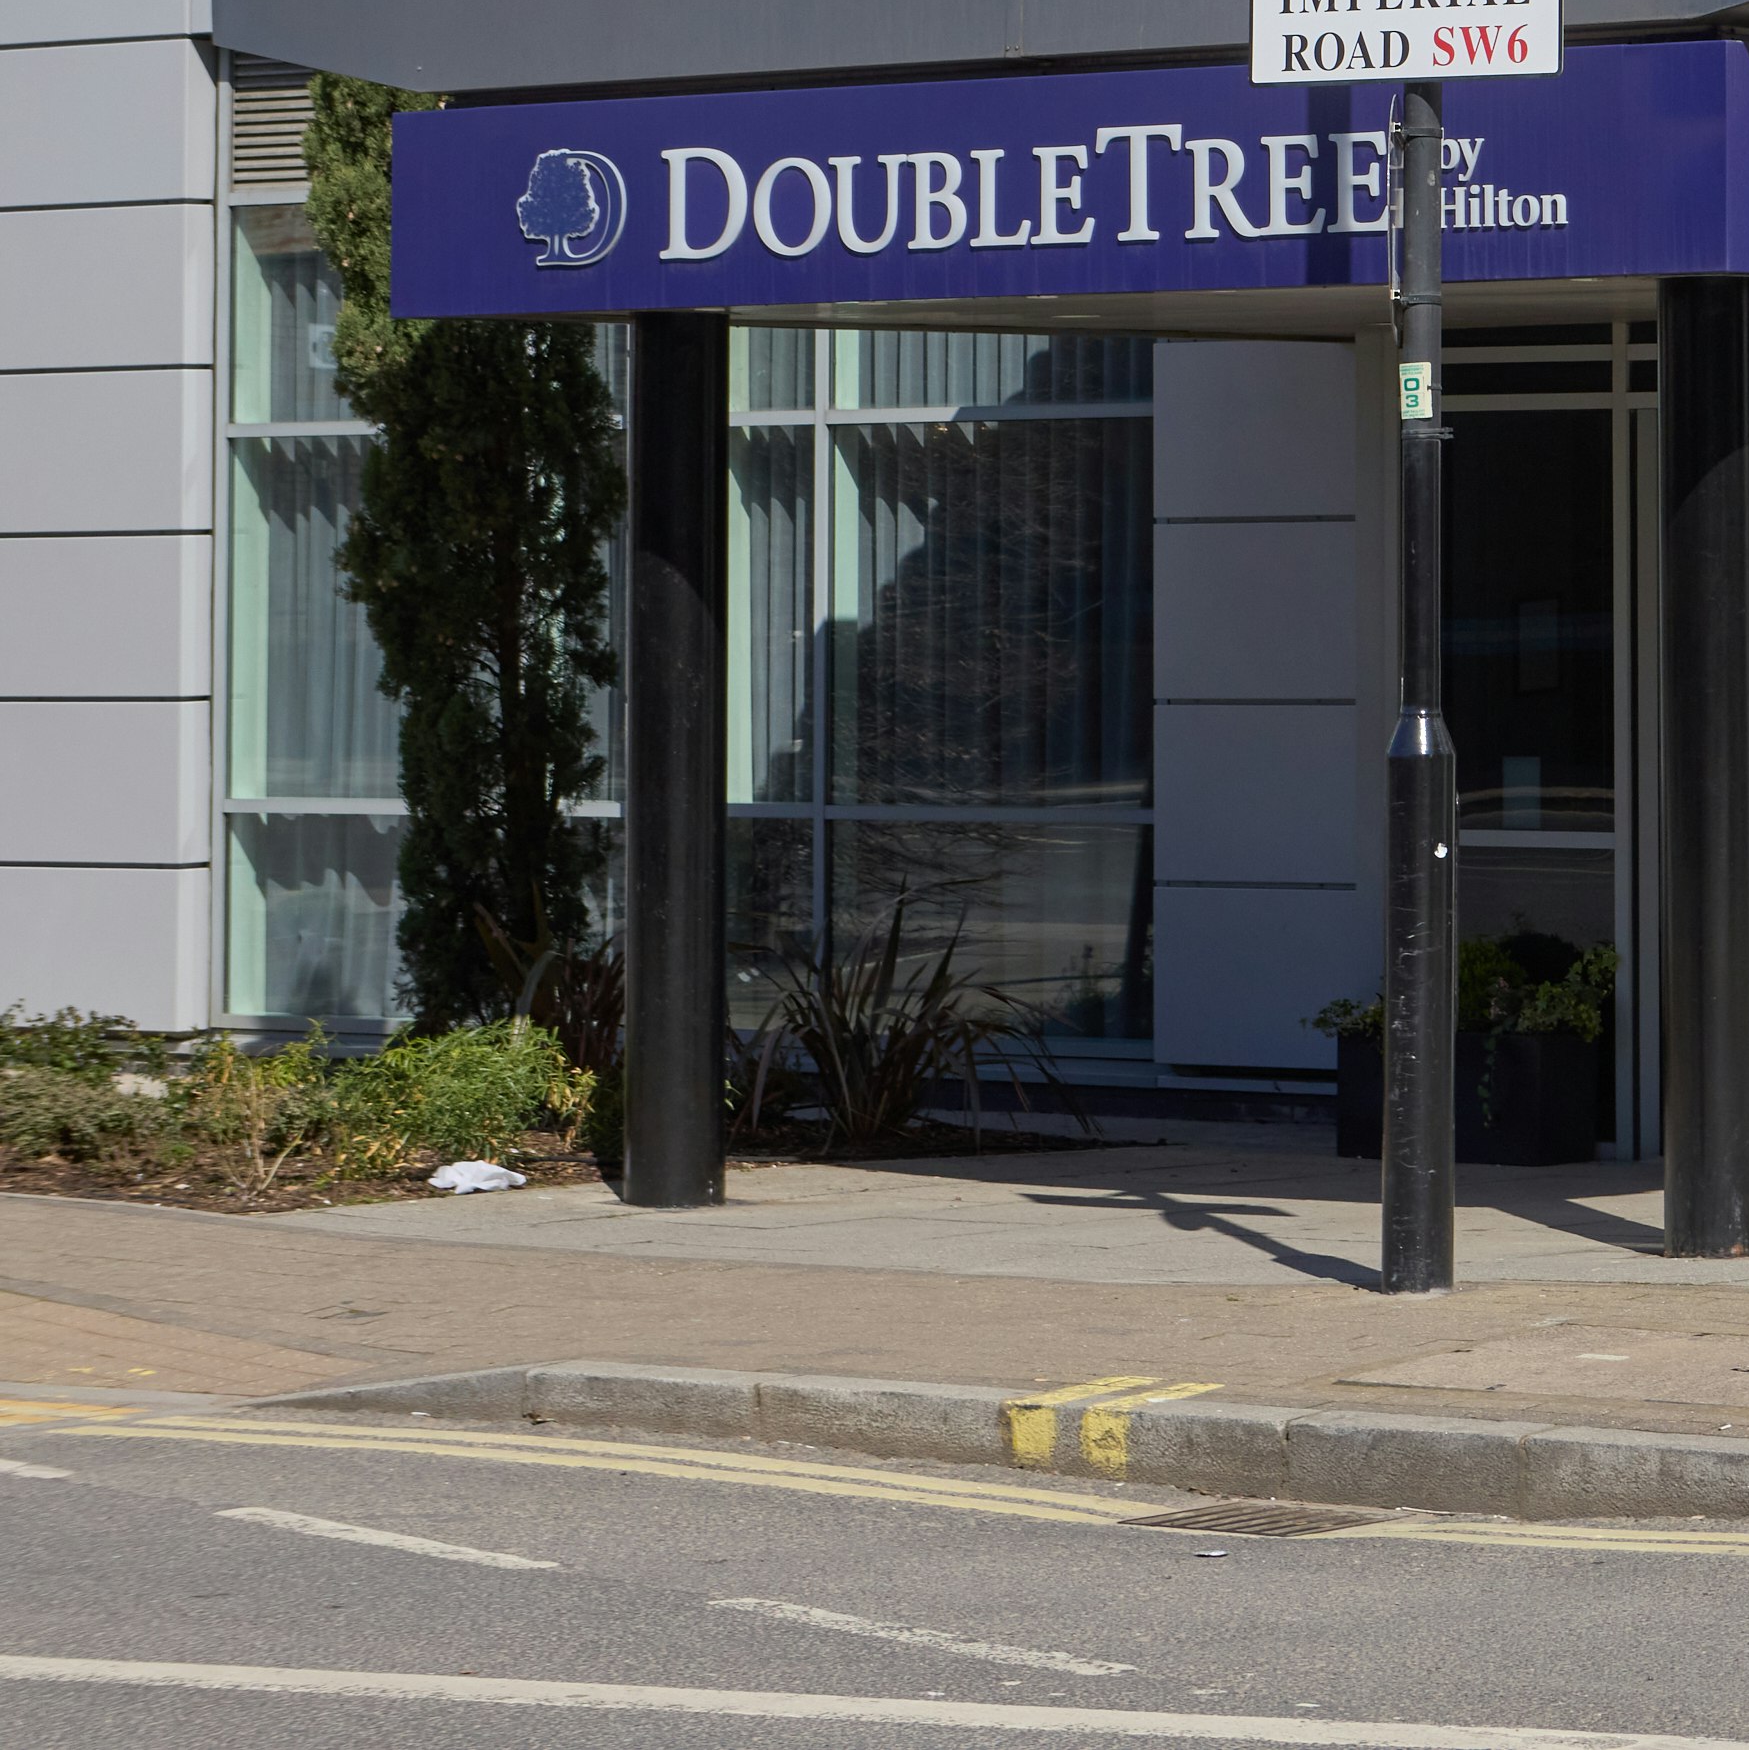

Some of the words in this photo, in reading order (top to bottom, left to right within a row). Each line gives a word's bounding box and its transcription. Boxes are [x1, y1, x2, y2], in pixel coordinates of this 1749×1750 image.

[1281, 30, 1410, 72] ROAD
[1432, 23, 1529, 67] SW6
[1441, 127, 1485, 182] by
[1441, 184, 1569, 229] Hilton
